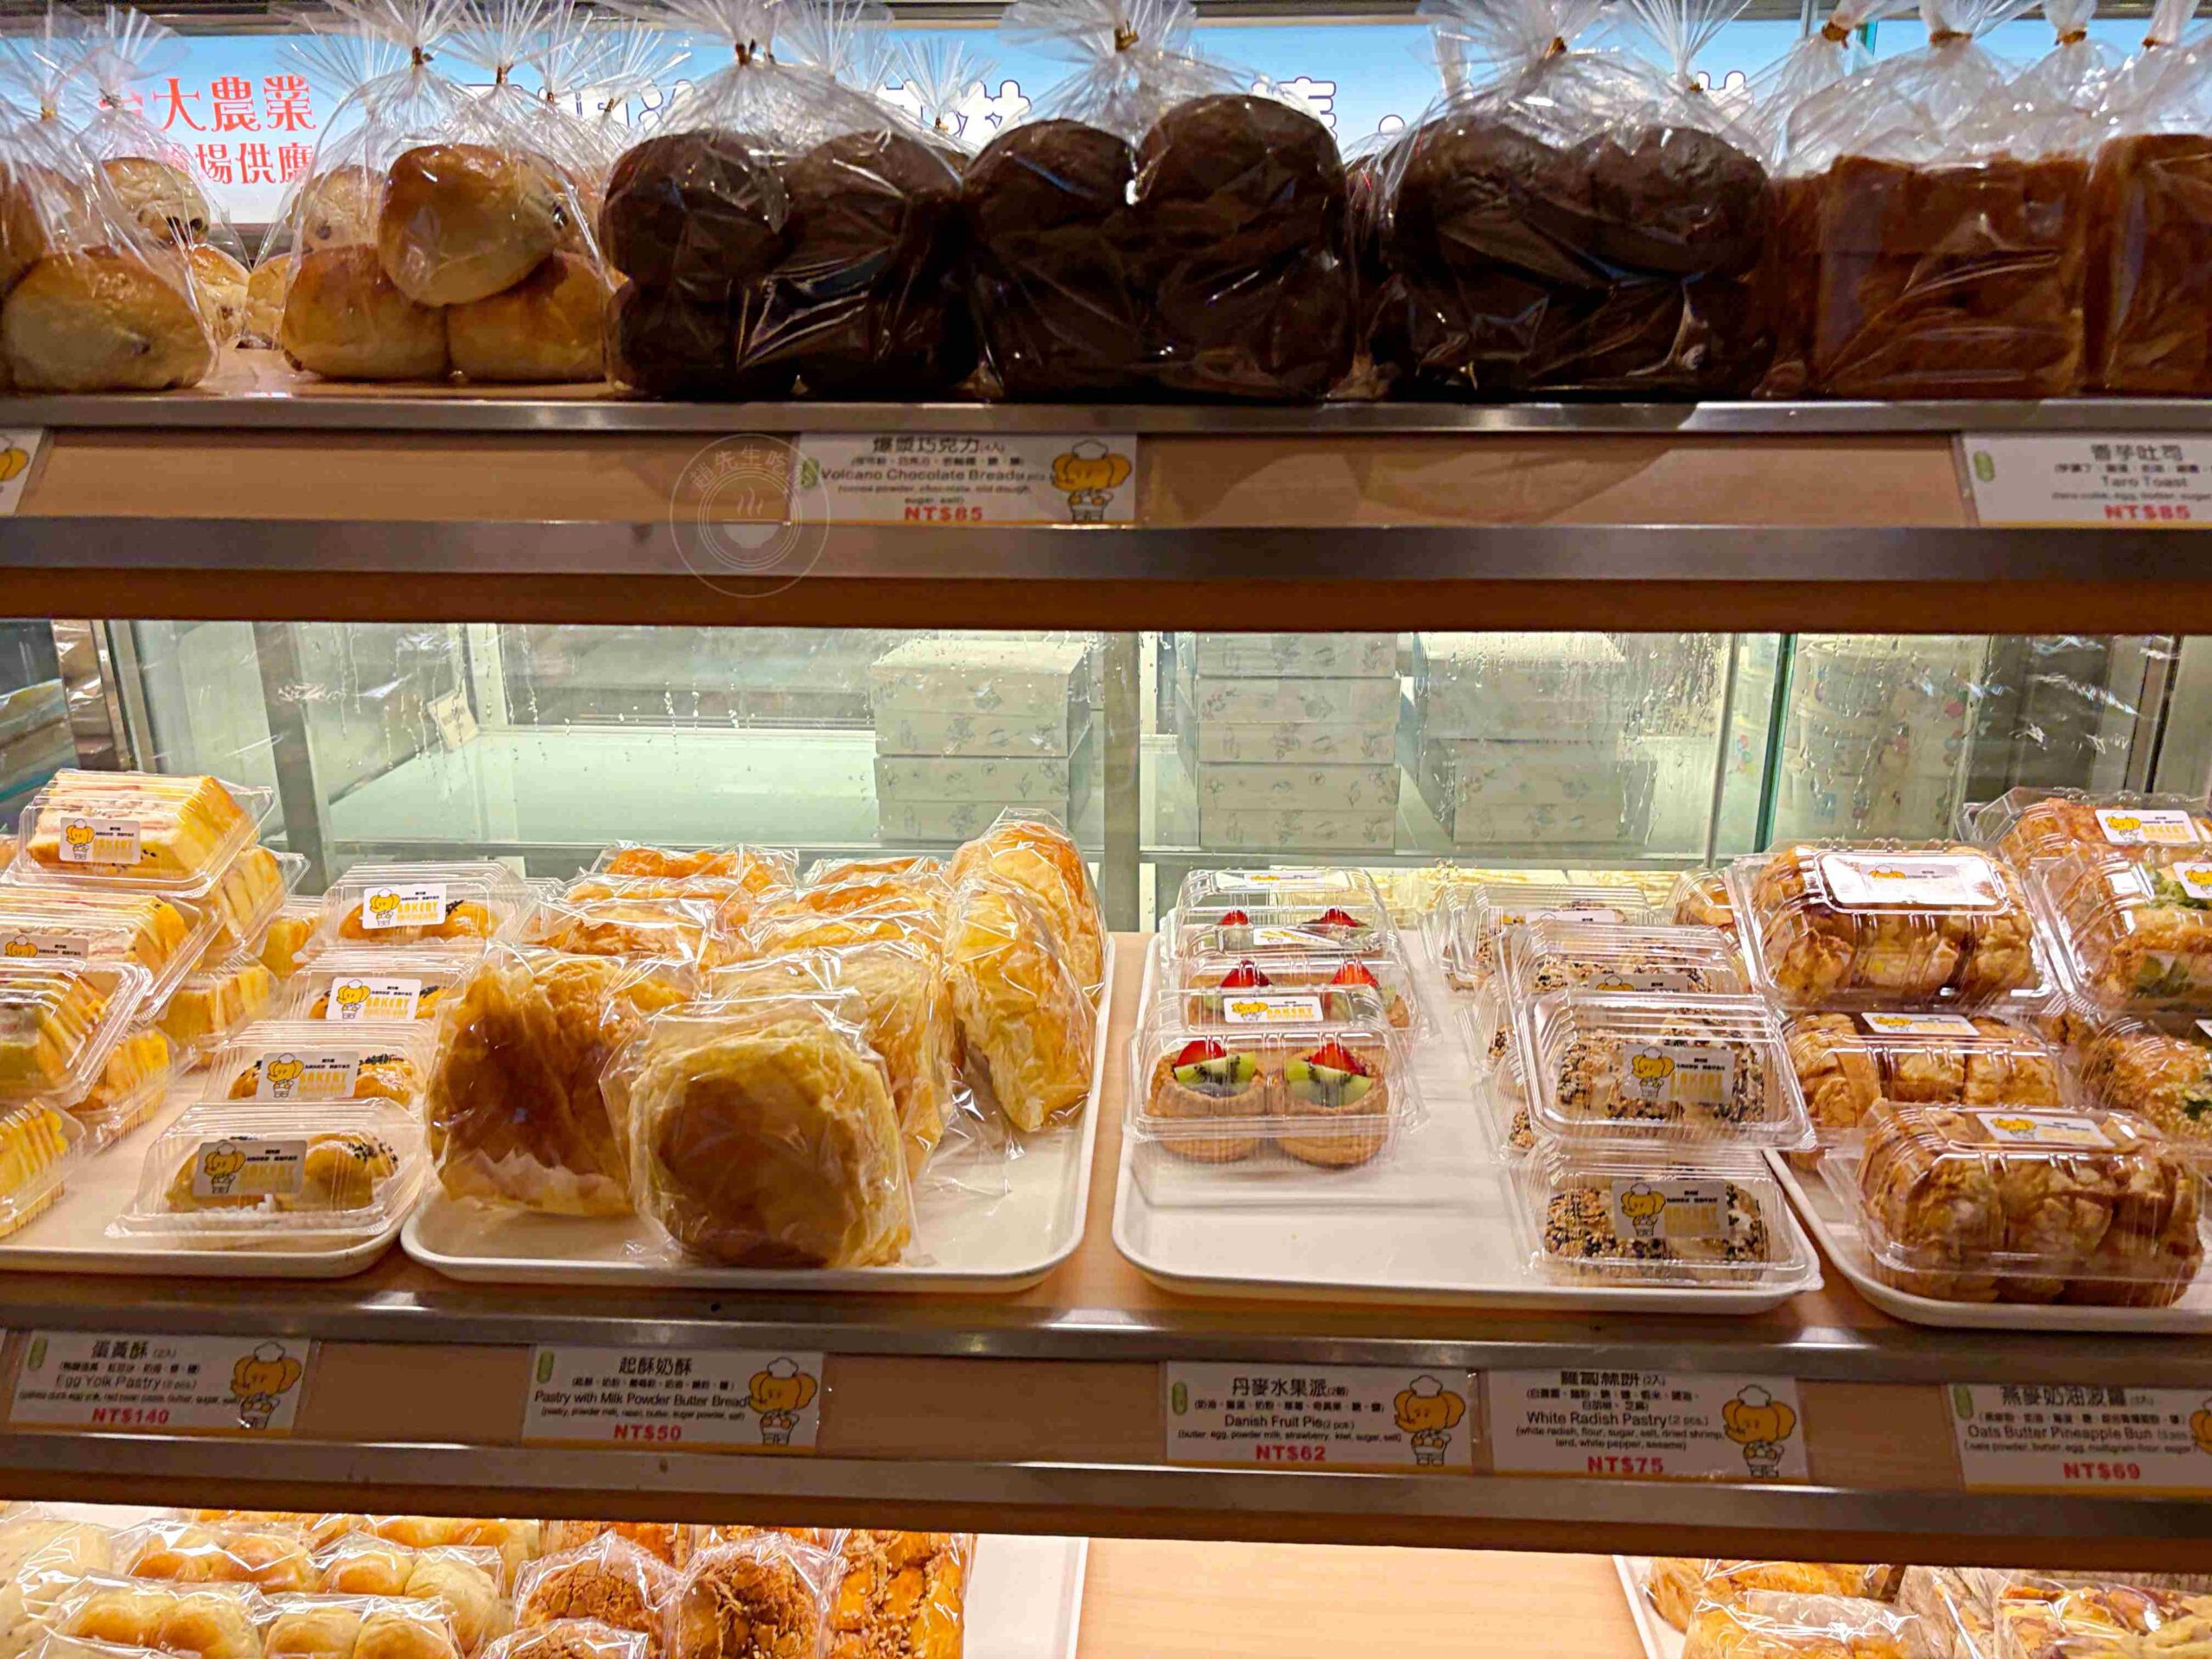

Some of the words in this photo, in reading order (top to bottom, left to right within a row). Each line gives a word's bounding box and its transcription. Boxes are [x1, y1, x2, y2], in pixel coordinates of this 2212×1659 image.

[822, 469, 882, 480] Volcano
[887, 468, 965, 480] Chocolate
[619, 1357, 693, 1376] 起酥奶酥
[55, 1375, 81, 1389] Egg
[86, 1376, 111, 1388] Yolk
[115, 1376, 162, 1391] Pastry
[535, 1389, 571, 1407] Pastry
[574, 1392, 598, 1403] with
[601, 1392, 623, 1404] Milk
[627, 1393, 671, 1406] Powder
[673, 1394, 708, 1407] Butter
[92, 1408, 170, 1424] NT$140
[1224, 1414, 1268, 1427] Danish
[1271, 1415, 1300, 1427] Fruit
[1527, 1411, 1567, 1424] White
[1570, 1412, 1618, 1425] Radish
[614, 1424, 682, 1441] NT$50
[1967, 1425, 2001, 1438] Oats
[2004, 1425, 2047, 1439] Butter
[2051, 1426, 2121, 1442] Pineapple
[2124, 1427, 2153, 1440] Bun
[1255, 1445, 1326, 1461] NT$62
[1587, 1456, 1664, 1473] NT$75
[2063, 1462, 2140, 1479] NT$69
